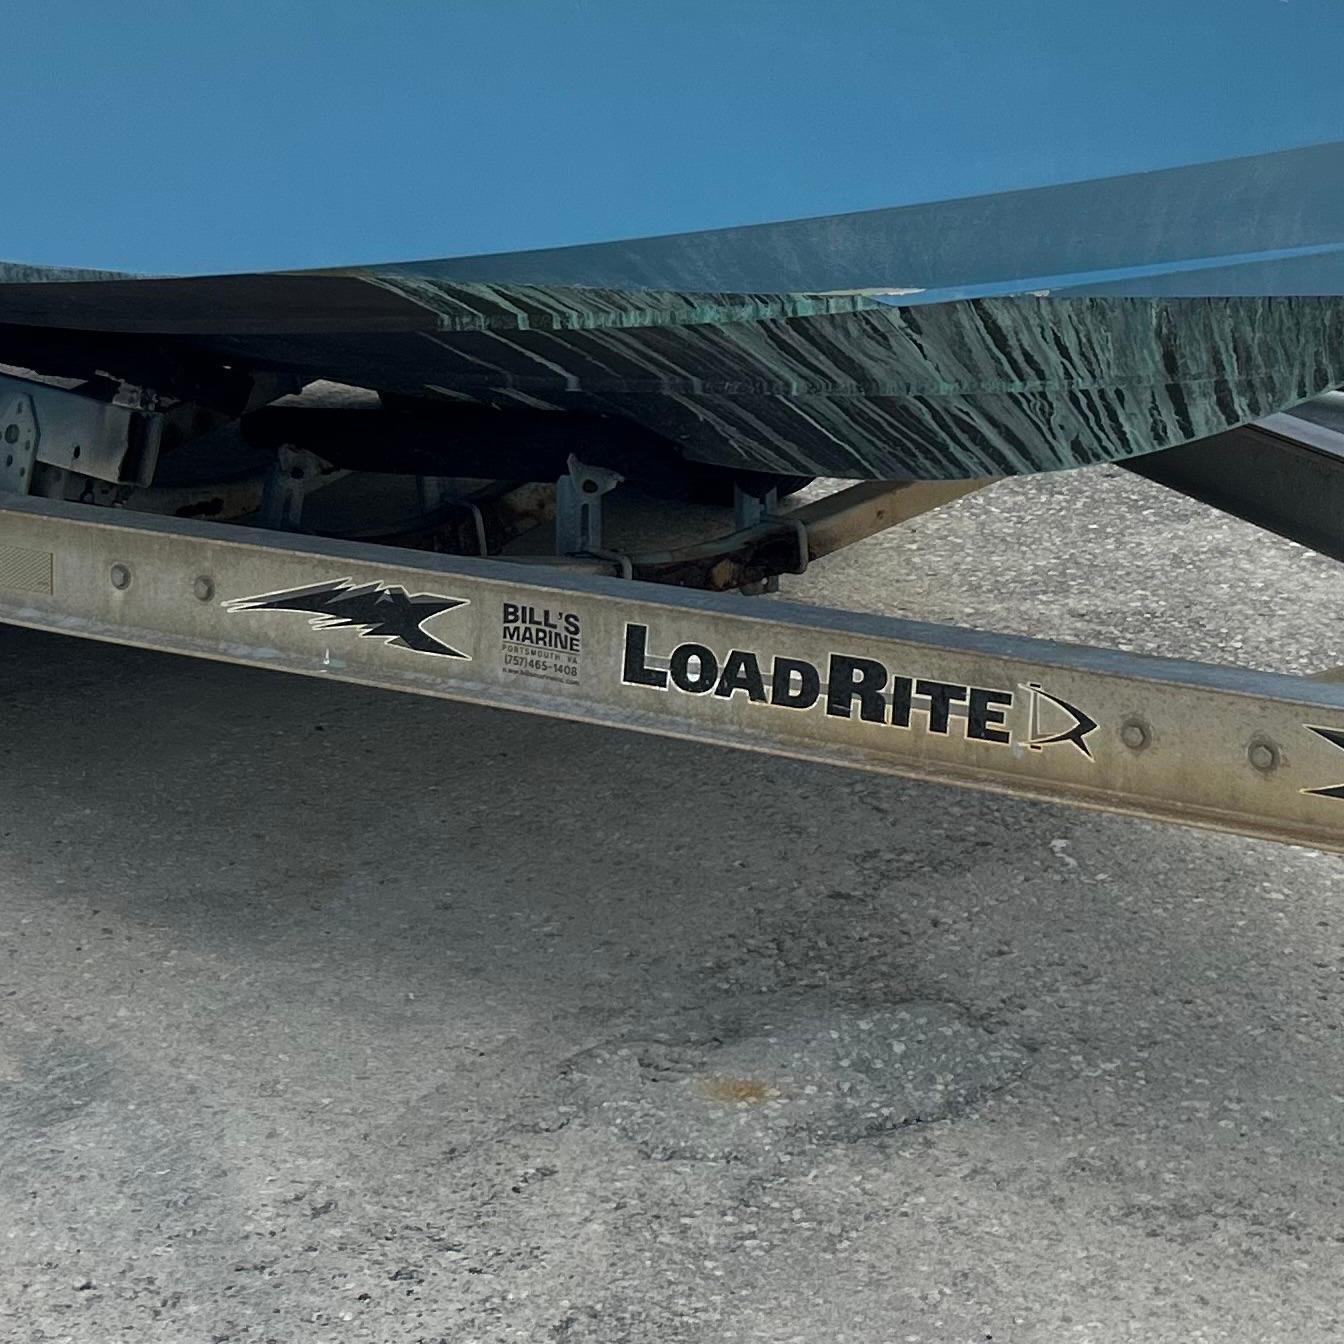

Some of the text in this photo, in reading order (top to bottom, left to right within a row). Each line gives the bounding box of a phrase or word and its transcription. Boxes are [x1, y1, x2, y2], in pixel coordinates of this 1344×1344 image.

[503, 603, 580, 636] BILL'S
[502, 625, 580, 652] MARINE
[502, 644, 561, 661] PORTSMOUTH
